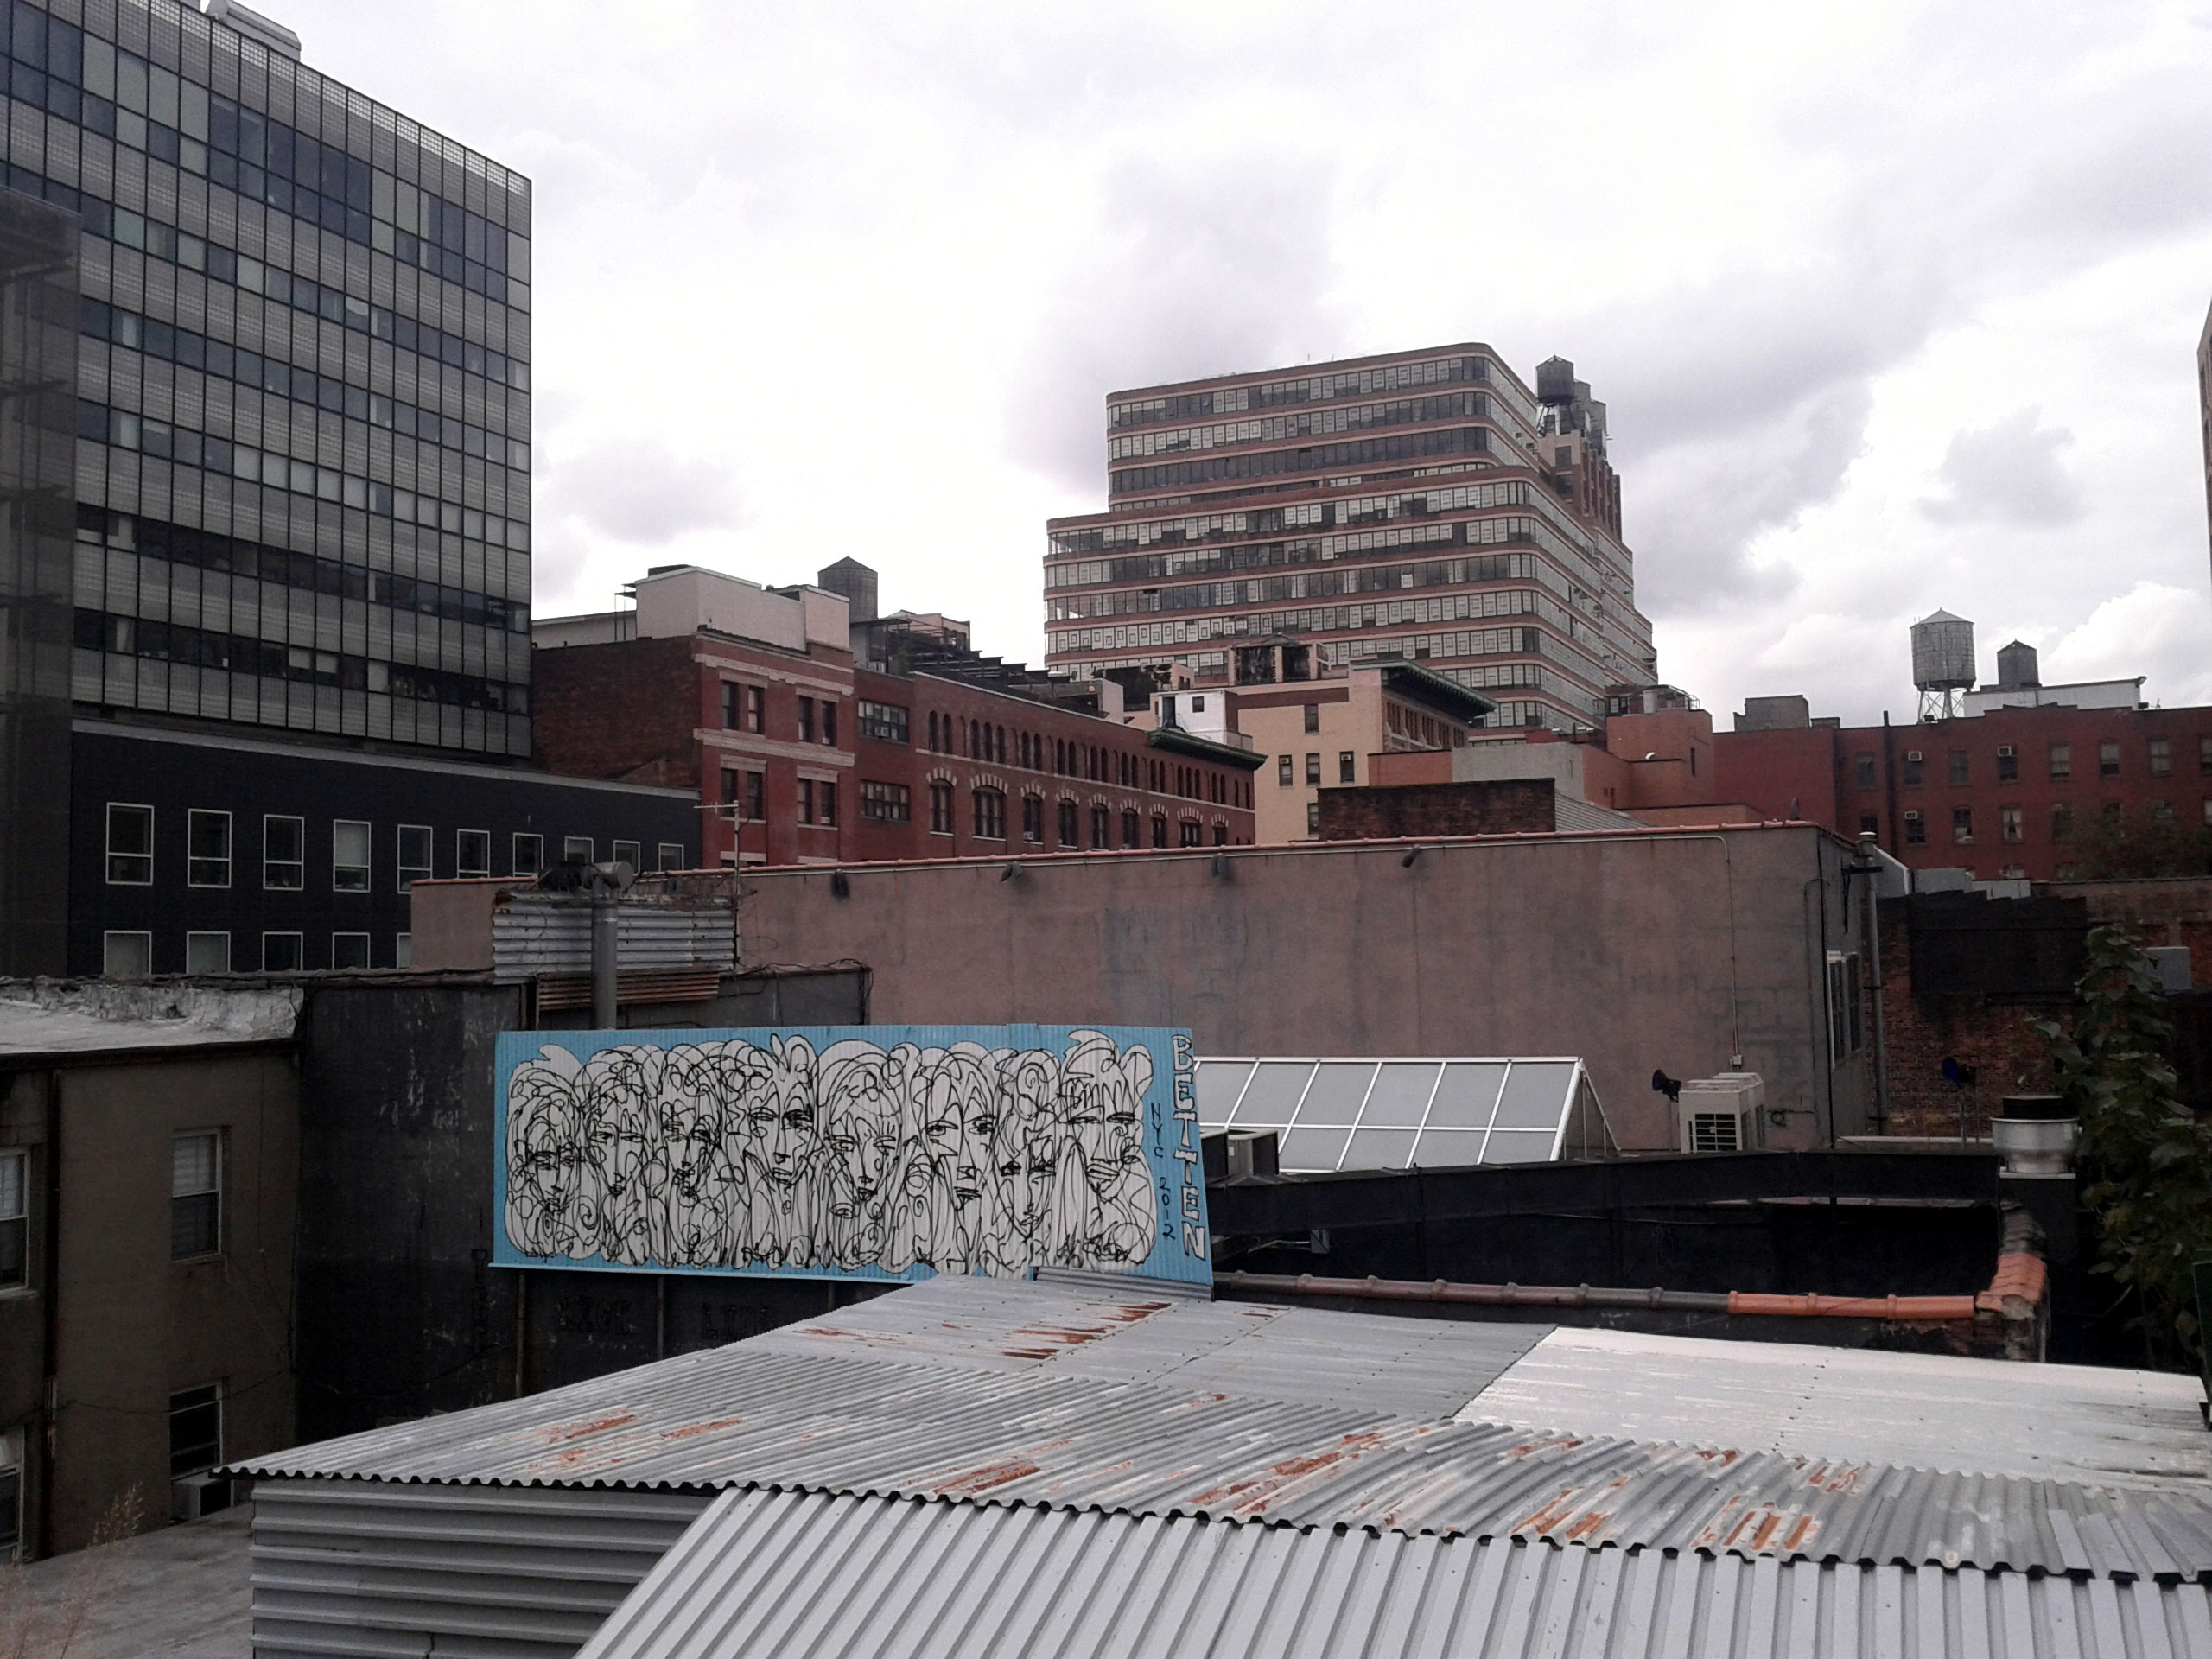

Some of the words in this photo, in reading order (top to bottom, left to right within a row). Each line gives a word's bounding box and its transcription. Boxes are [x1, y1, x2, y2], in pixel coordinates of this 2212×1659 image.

[1150, 1102, 1164, 1159] NYC
[1158, 1176, 1176, 1241] 2012
[1171, 1033, 1206, 1262] BETTEN
